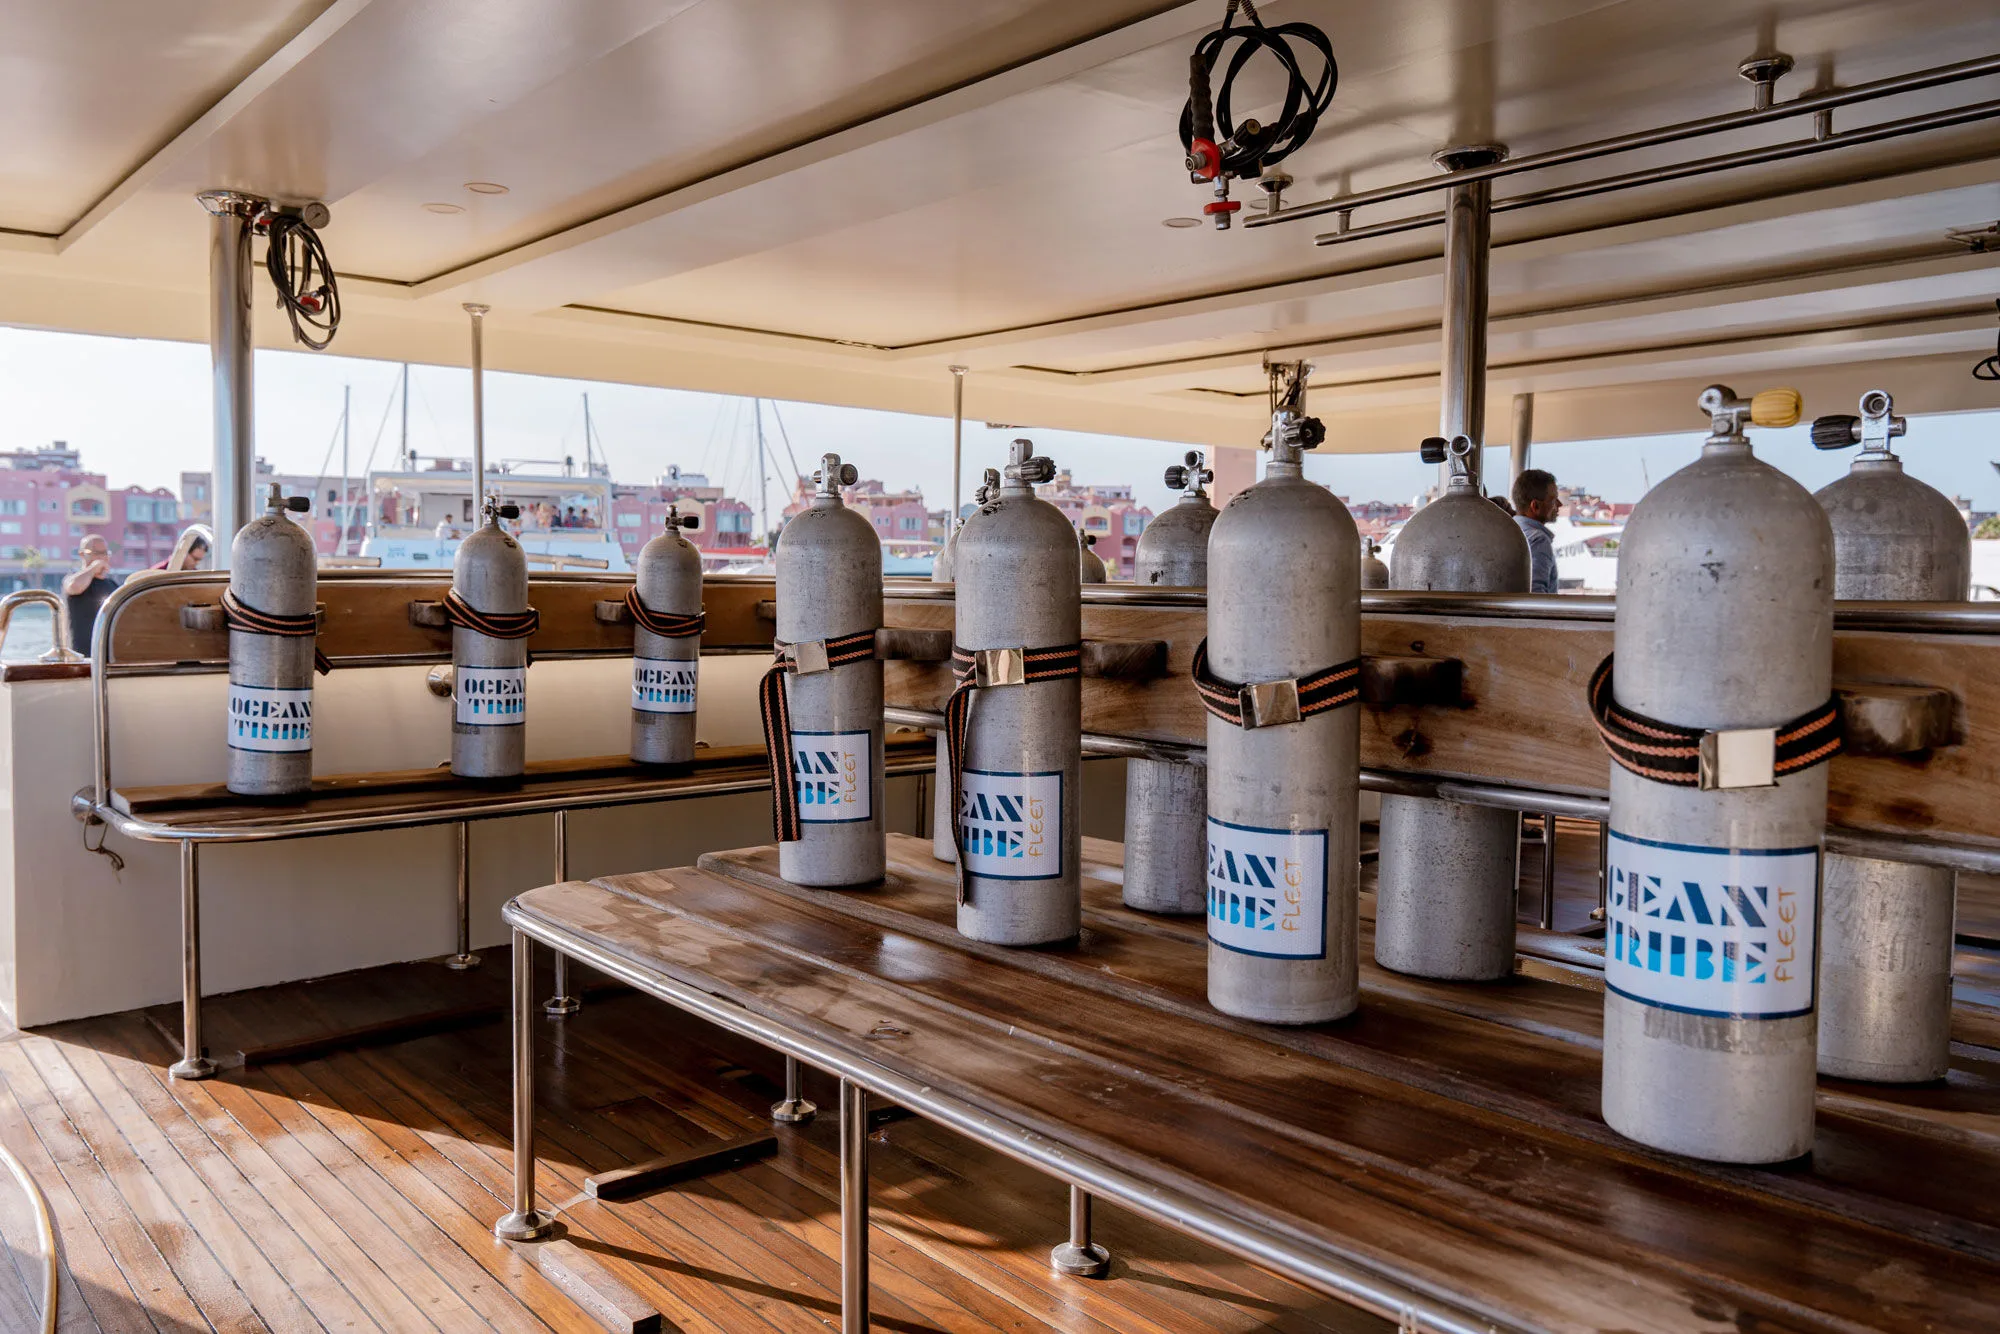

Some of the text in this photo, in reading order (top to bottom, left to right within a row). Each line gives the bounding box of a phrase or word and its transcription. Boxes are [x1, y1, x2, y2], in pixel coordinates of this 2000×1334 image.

[465, 678, 526, 695] OCEA
[635, 667, 696, 685] OCEAN
[232, 697, 312, 719] OCEAN
[468, 698, 525, 714] TRIB
[636, 685, 696, 703] TRIBE
[234, 719, 312, 740] TRIBE
[844, 751, 857, 803] FLEET
[961, 789, 1024, 823] EAN
[962, 825, 1024, 858] IBE
[1028, 796, 1044, 857] FLEET
[1208, 843, 1276, 889] EAN
[1282, 857, 1303, 932] FLEET
[1608, 864, 1768, 928] CEAN
[1606, 915, 1767, 983] RIBE
[1774, 886, 1797, 983] FLEET
